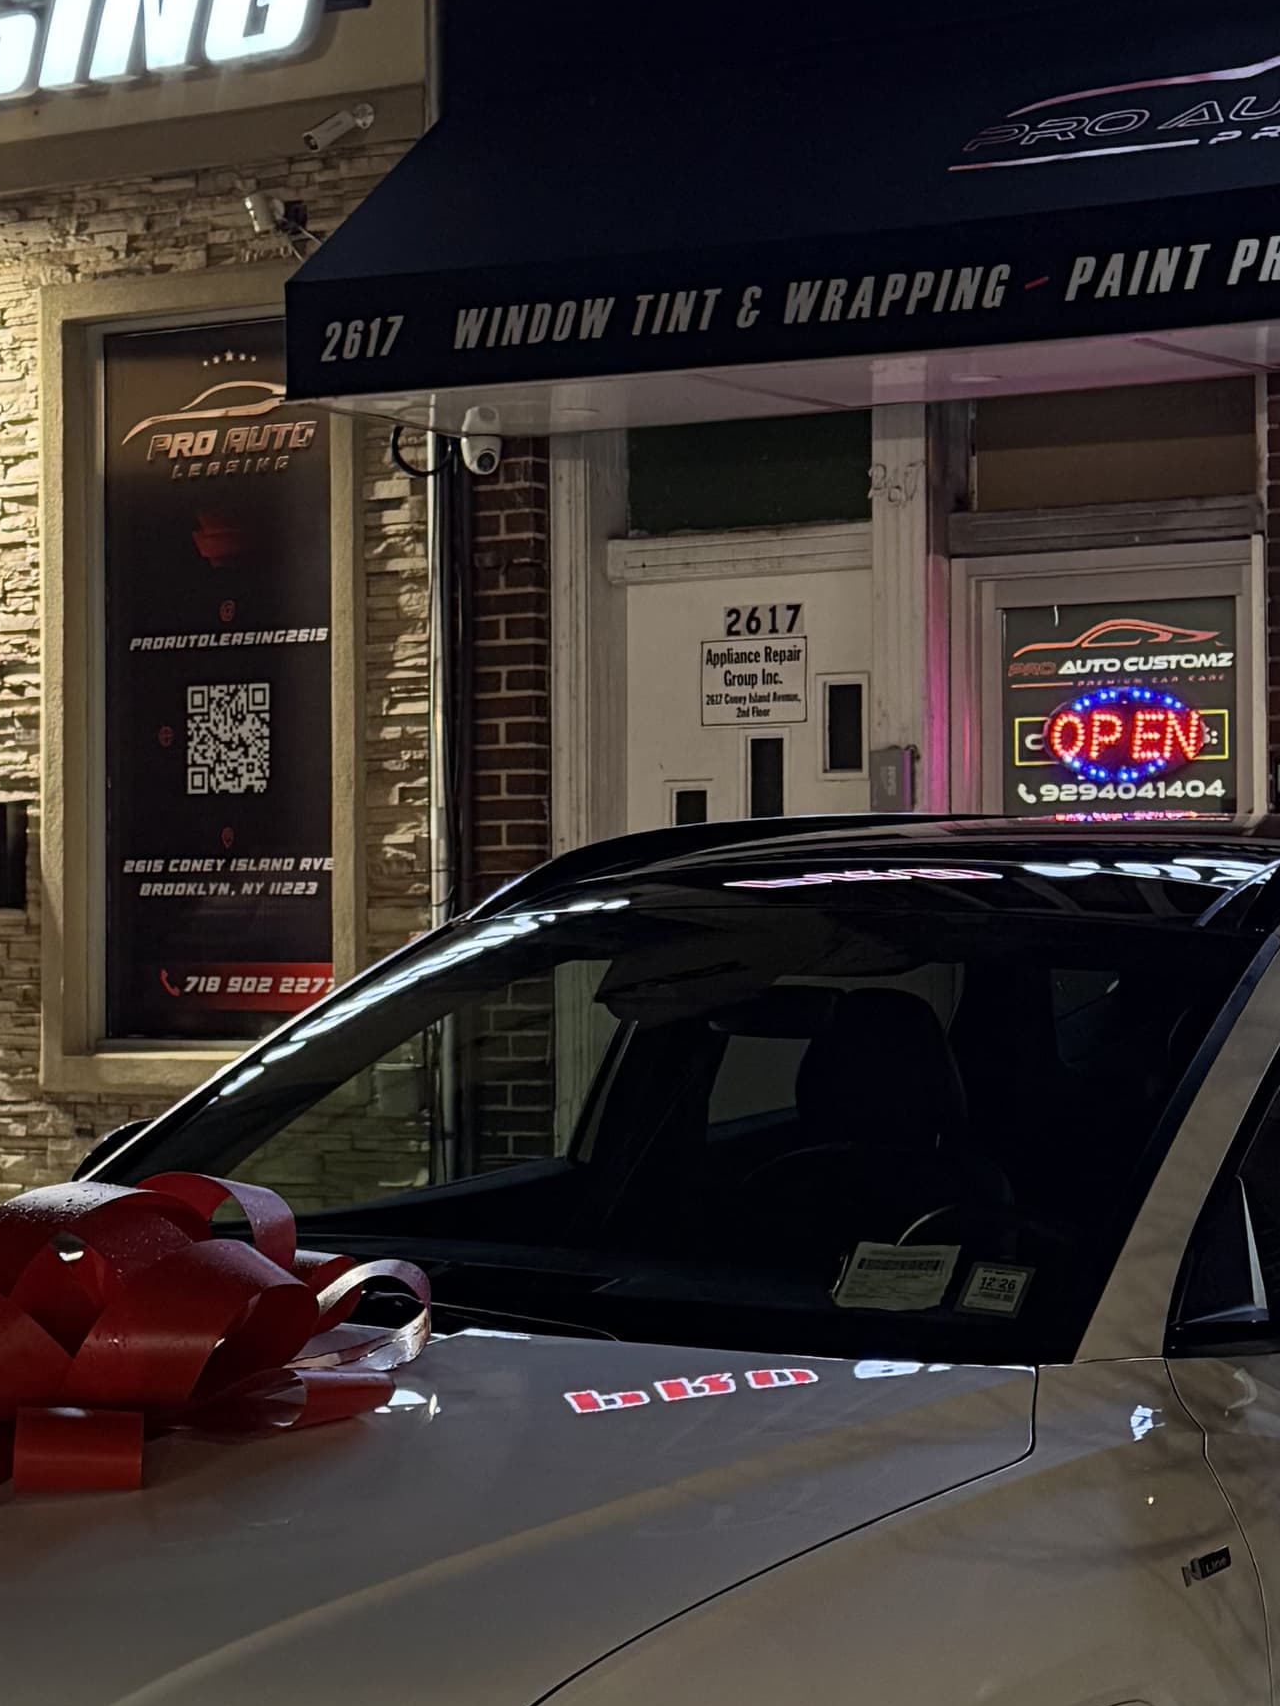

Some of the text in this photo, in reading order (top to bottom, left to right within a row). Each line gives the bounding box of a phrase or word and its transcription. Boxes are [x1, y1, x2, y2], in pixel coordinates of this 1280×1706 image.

[963, 109, 1150, 152] PRO
[452, 296, 615, 351] WINDOW
[630, 287, 723, 338] TINT
[736, 285, 762, 329] &
[782, 263, 1012, 327] WRAPPING
[1064, 243, 1212, 303] PAINT
[320, 314, 405, 363] 2617
[147, 421, 317, 461] PRO AUTO
[172, 456, 290, 479] LEASING
[725, 603, 803, 637] 2617
[129, 628, 329, 651] PROAUTOLEASING2615
[705, 645, 803, 669] Appliance Repair
[1008, 652, 1235, 677] PRO AUTO CUSTOMZ
[723, 668, 783, 689] Group Inc.
[1048, 709, 1204, 762] OPEN
[1039, 778, 1226, 803] 9294041404
[123, 856, 334, 874] 2615 CONEY ISLAND AVE
[242, 882, 265, 897] NY
[269, 881, 318, 896] 11223
[183, 976, 221, 993] 718
[227, 975, 274, 993] 902
